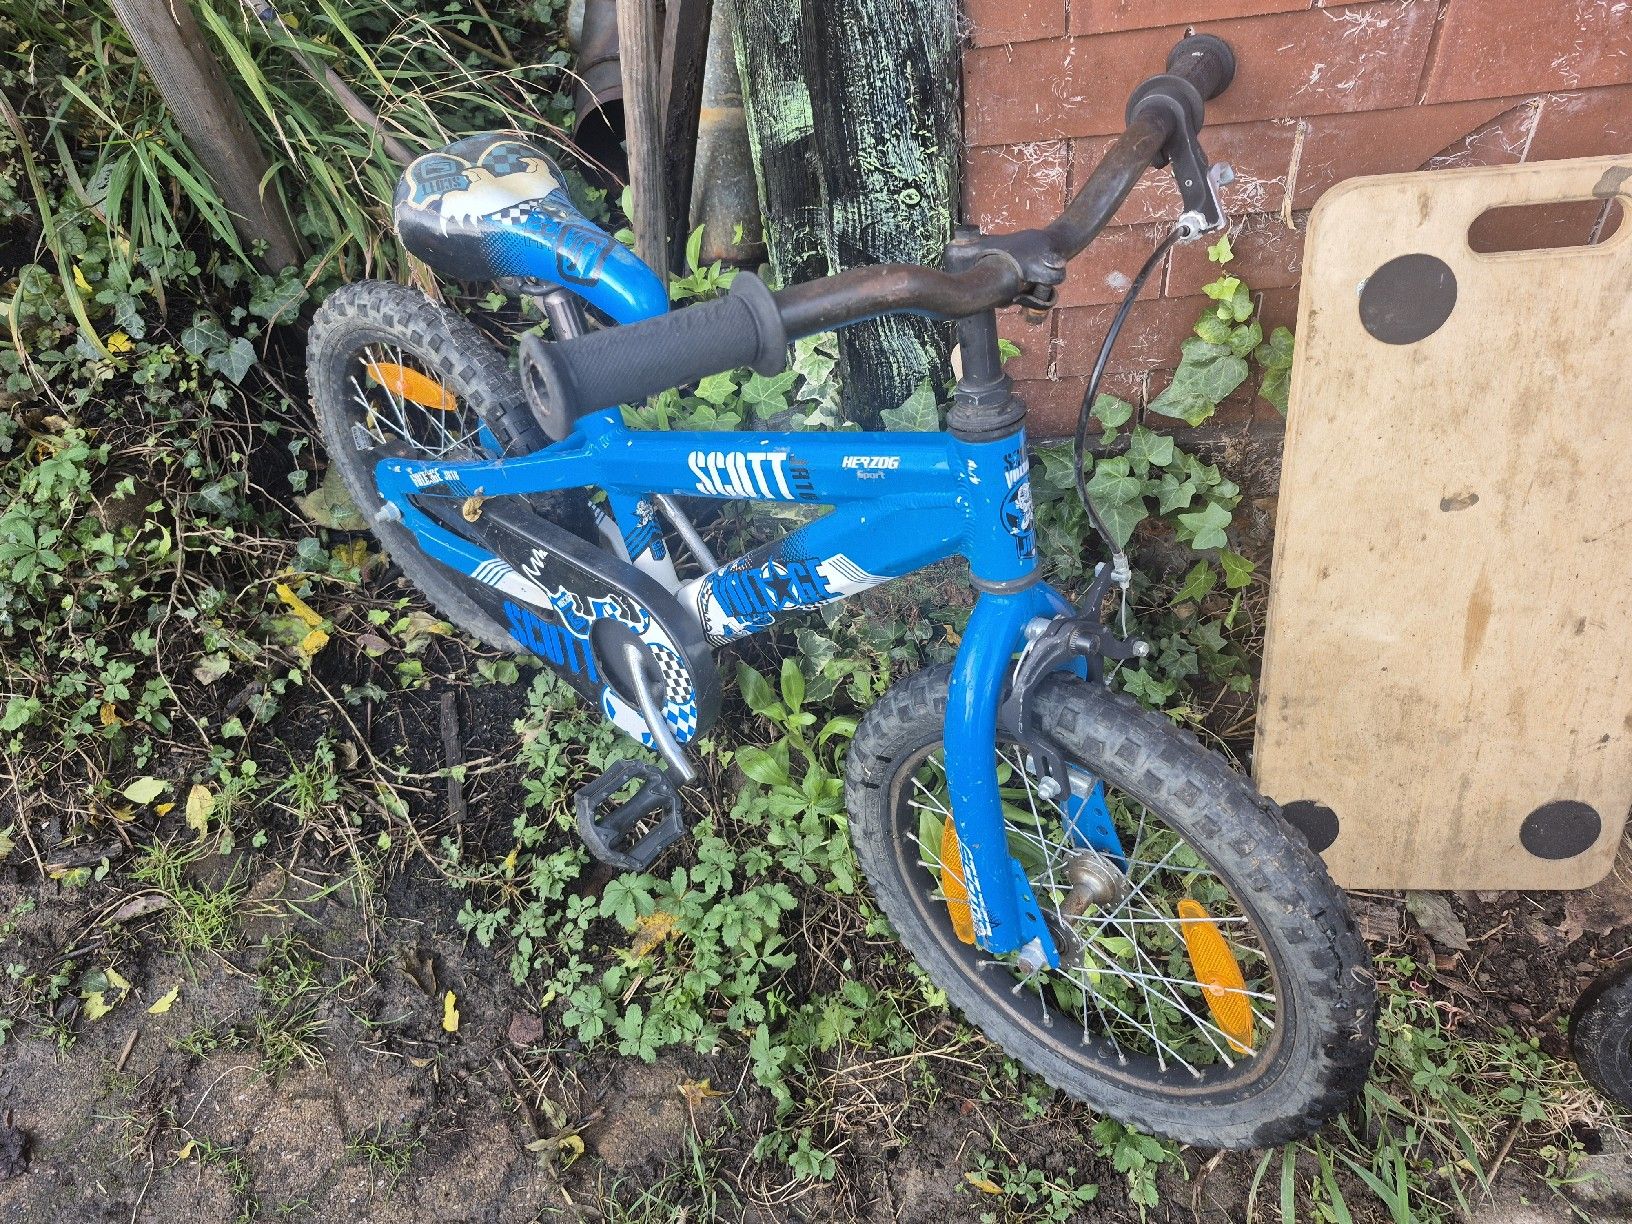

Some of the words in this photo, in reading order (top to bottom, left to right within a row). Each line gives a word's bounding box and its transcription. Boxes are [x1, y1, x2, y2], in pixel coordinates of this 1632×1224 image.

[841, 455, 901, 470] HERZOG
[687, 450, 795, 500] SCOTT
[856, 470, 886, 480] Sport
